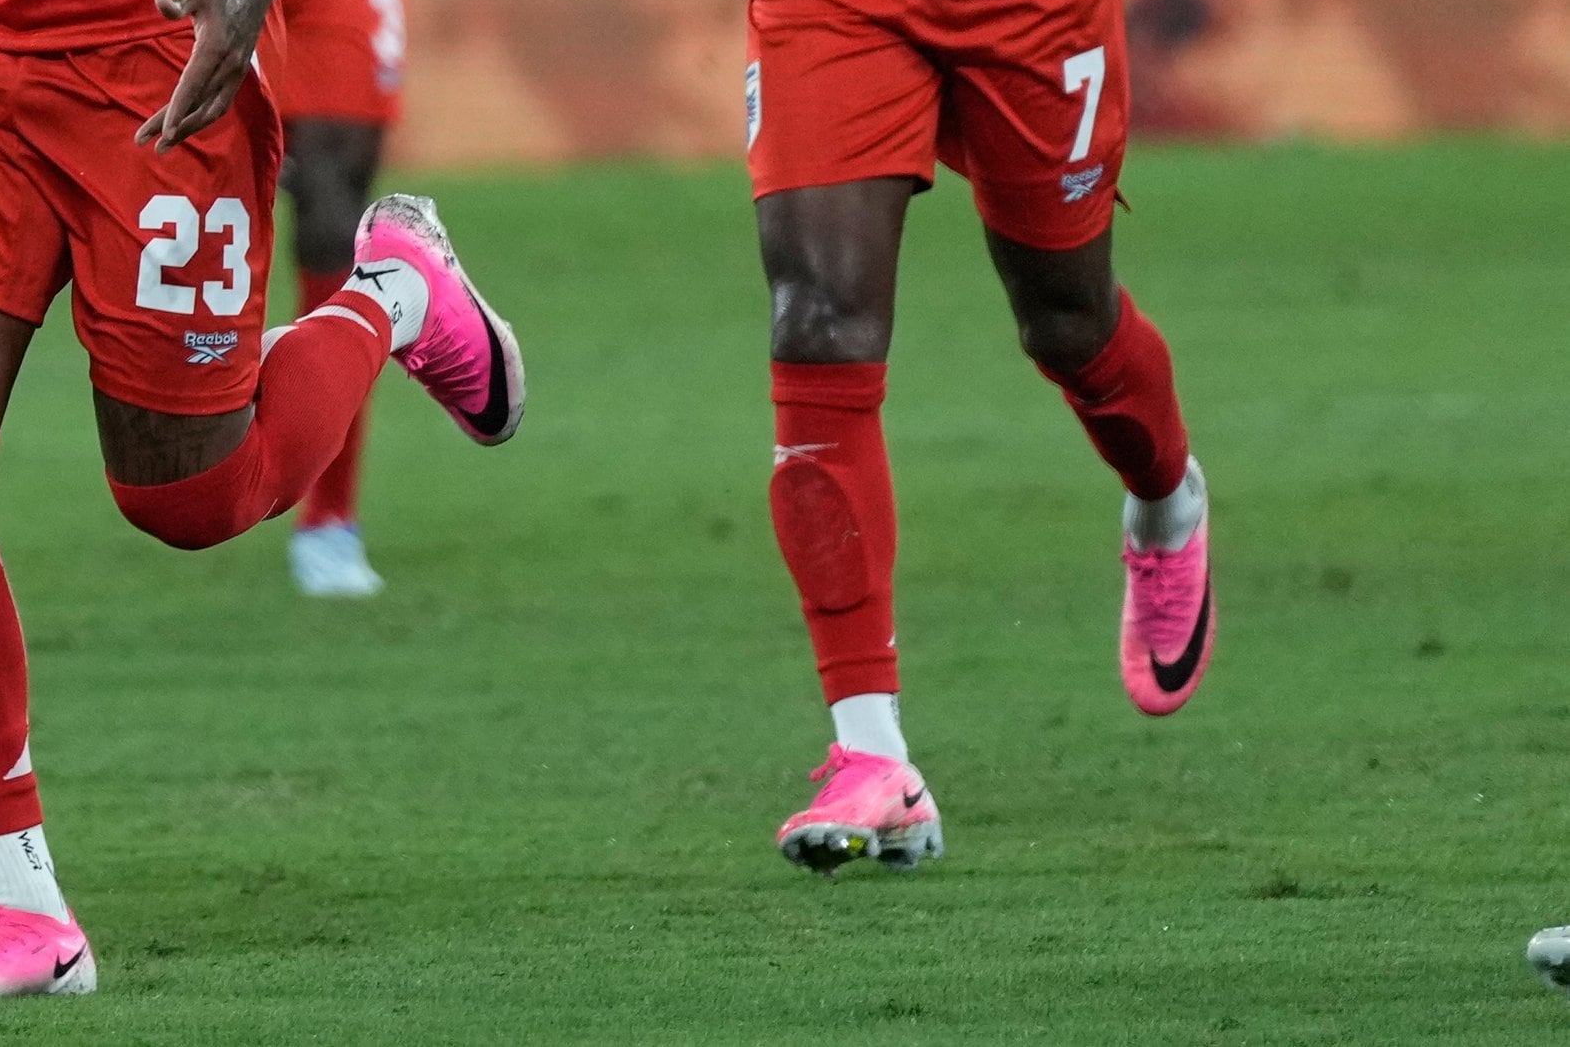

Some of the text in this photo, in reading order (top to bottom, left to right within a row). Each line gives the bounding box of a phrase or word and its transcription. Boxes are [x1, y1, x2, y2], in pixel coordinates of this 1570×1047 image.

[1063, 45, 1106, 163] 7
[135, 194, 252, 316] 23
[184, 330, 239, 347] Reebok
